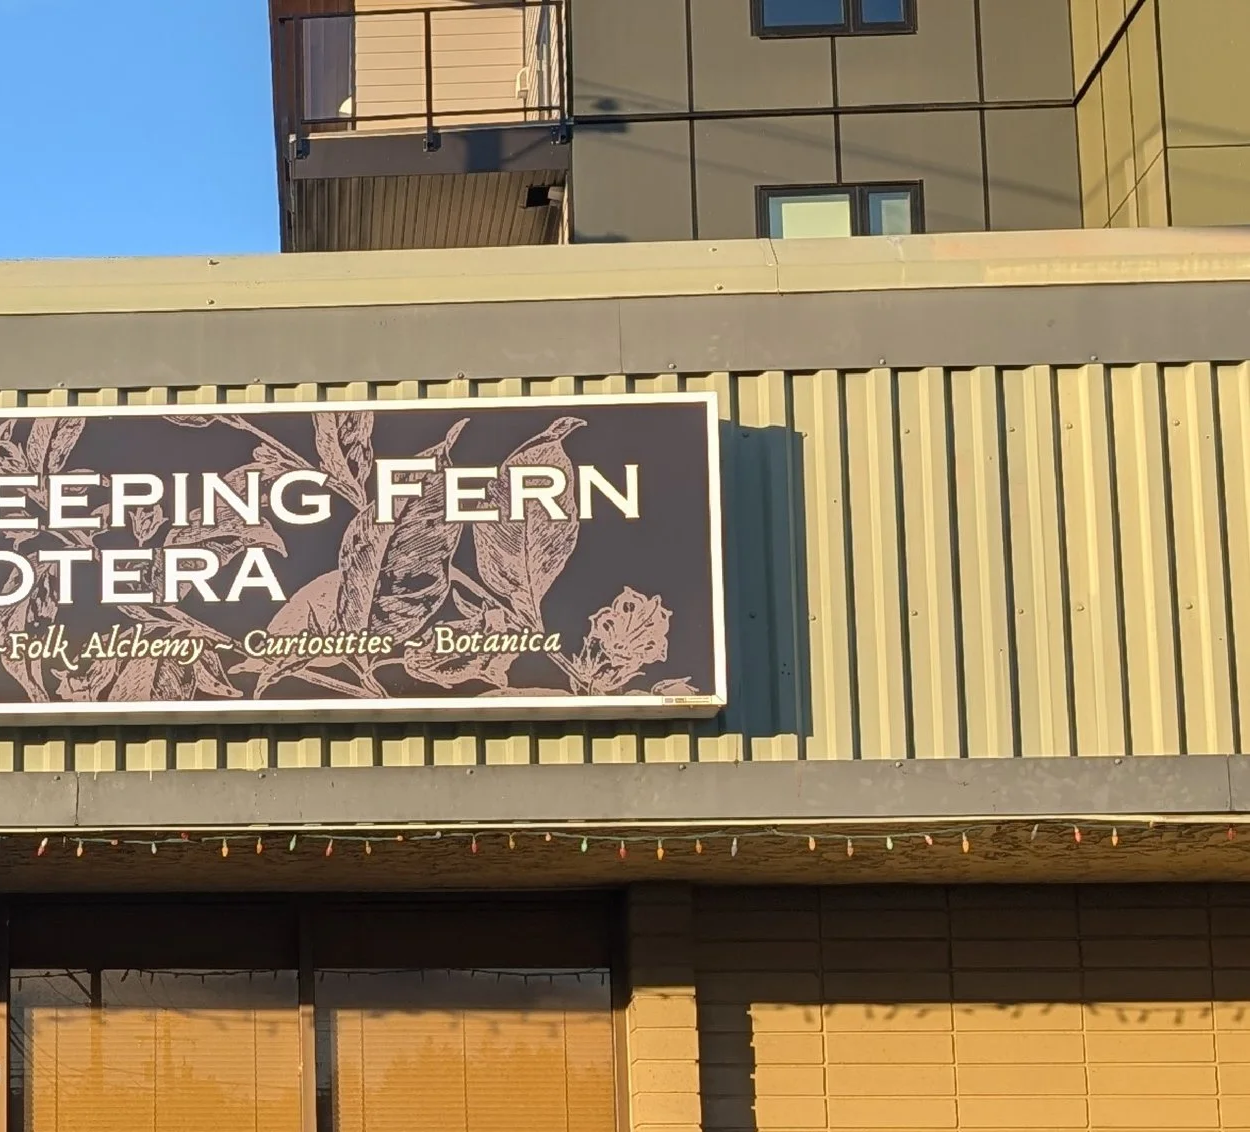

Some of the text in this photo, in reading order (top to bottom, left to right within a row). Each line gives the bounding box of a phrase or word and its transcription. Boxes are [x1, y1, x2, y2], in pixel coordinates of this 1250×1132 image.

[374, 457, 640, 524] FERN
[8, 625, 78, 671] Folk
[80, 624, 205, 666] Alchemy
[244, 628, 392, 658] Curiosities
[435, 627, 562, 655] Botanica
